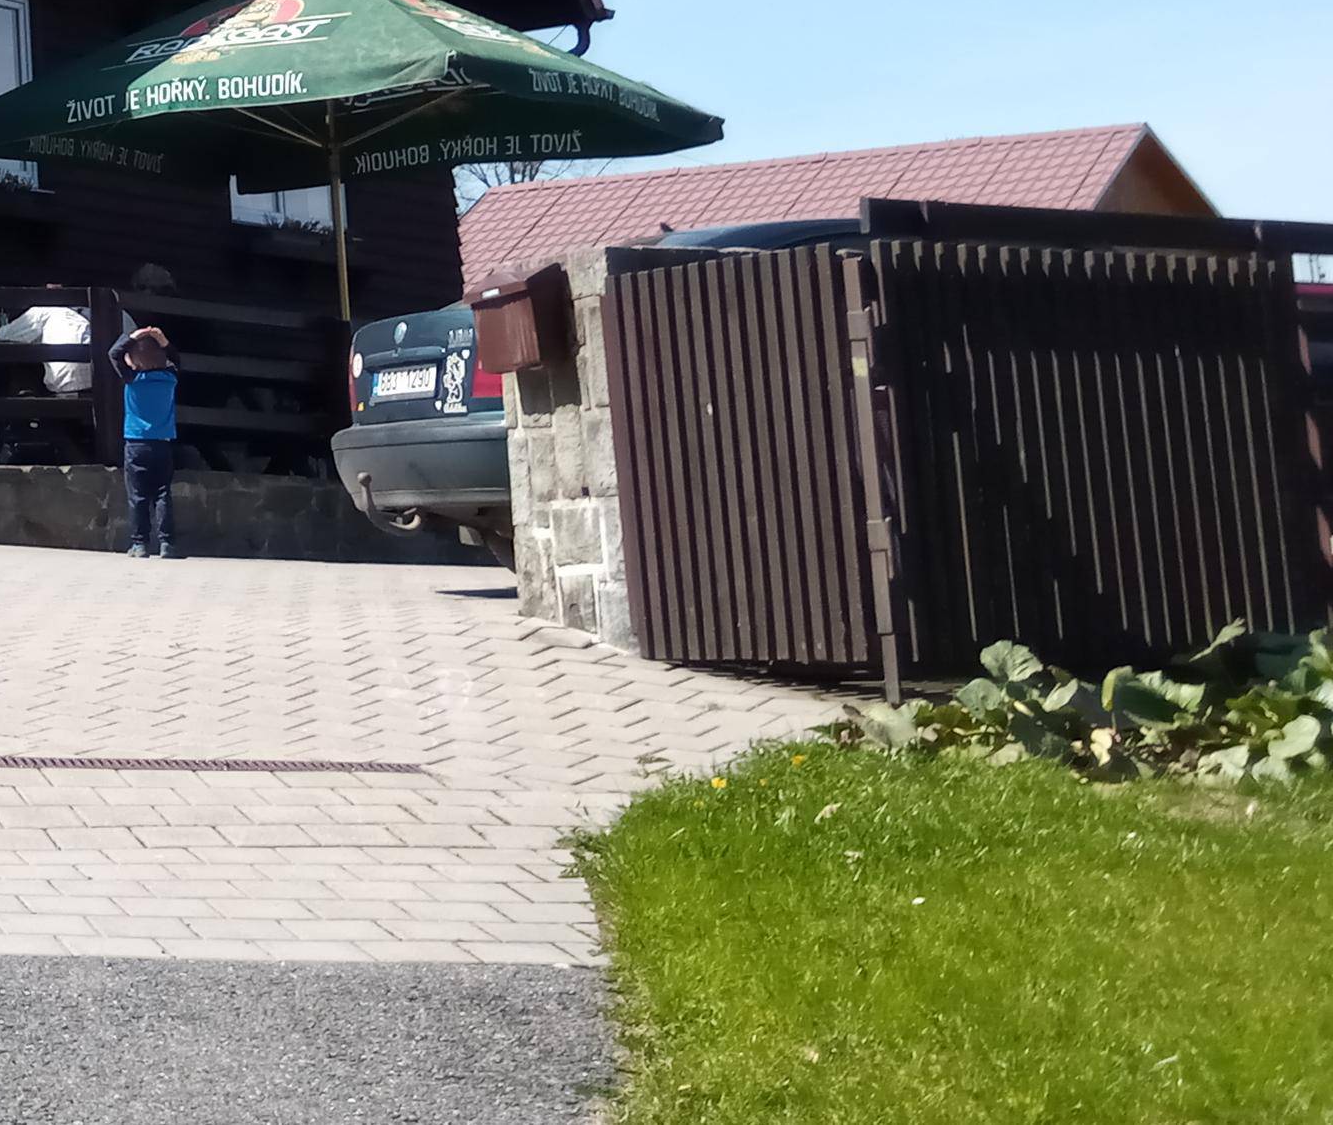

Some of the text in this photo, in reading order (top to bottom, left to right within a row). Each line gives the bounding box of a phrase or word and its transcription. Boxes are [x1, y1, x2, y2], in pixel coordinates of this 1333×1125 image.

[66, 94, 116, 124] ŽIVOT
[122, 88, 141, 112] JE
[146, 75, 210, 108] HOŘKÝ.
[218, 69, 308, 100] BOHUDÍK.
